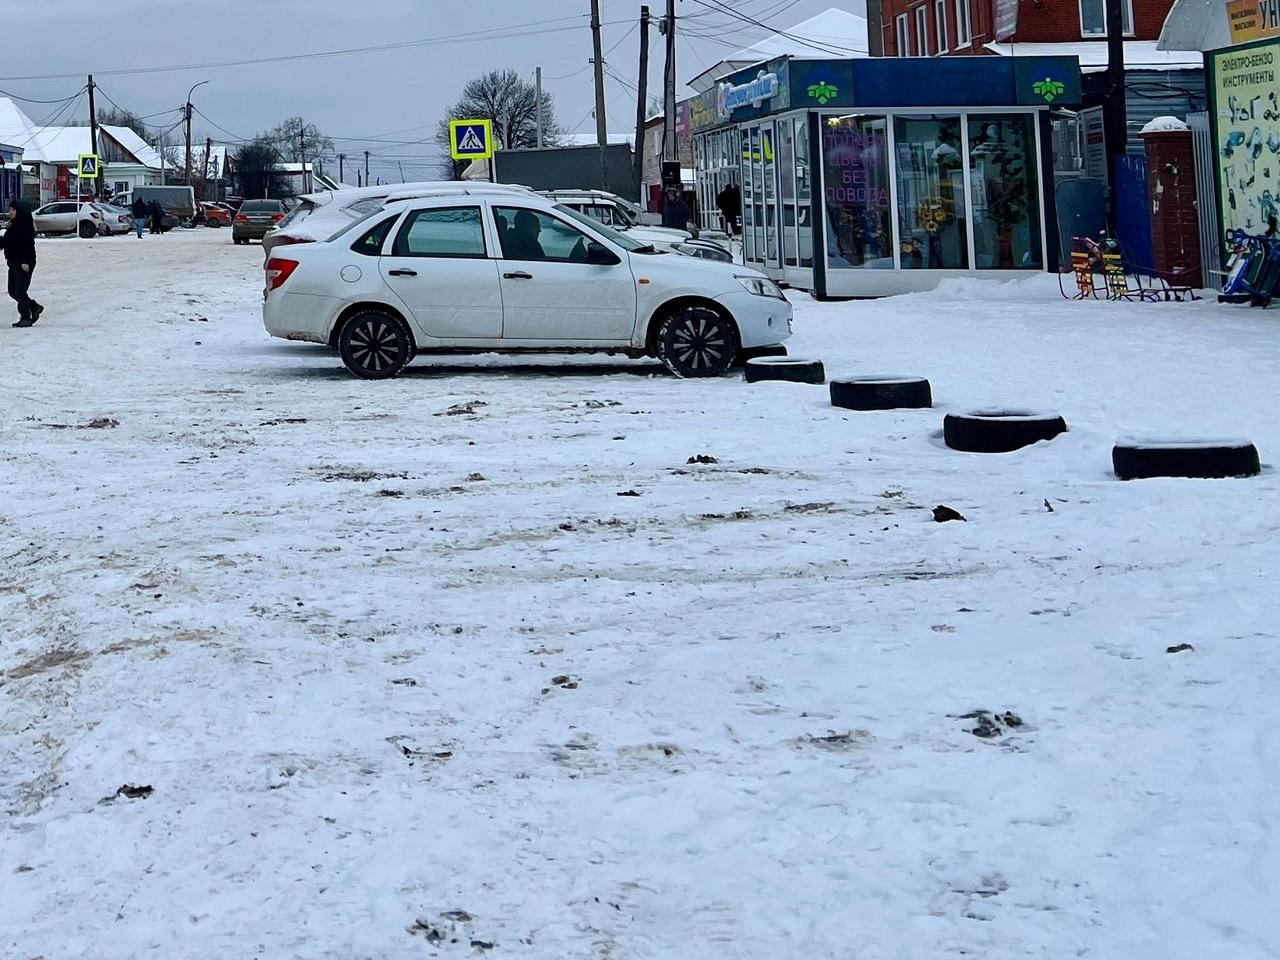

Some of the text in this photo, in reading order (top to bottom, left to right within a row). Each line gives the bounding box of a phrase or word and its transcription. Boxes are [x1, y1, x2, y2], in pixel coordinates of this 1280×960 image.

[1222, 52, 1274, 71] ЭЛЕКТРО-БЕНЗО
[1222, 70, 1275, 88] ИНСТРУМЕНТЫ
[842, 169, 870, 184] БЕЗ
[825, 187, 889, 203] ПОВОДА
